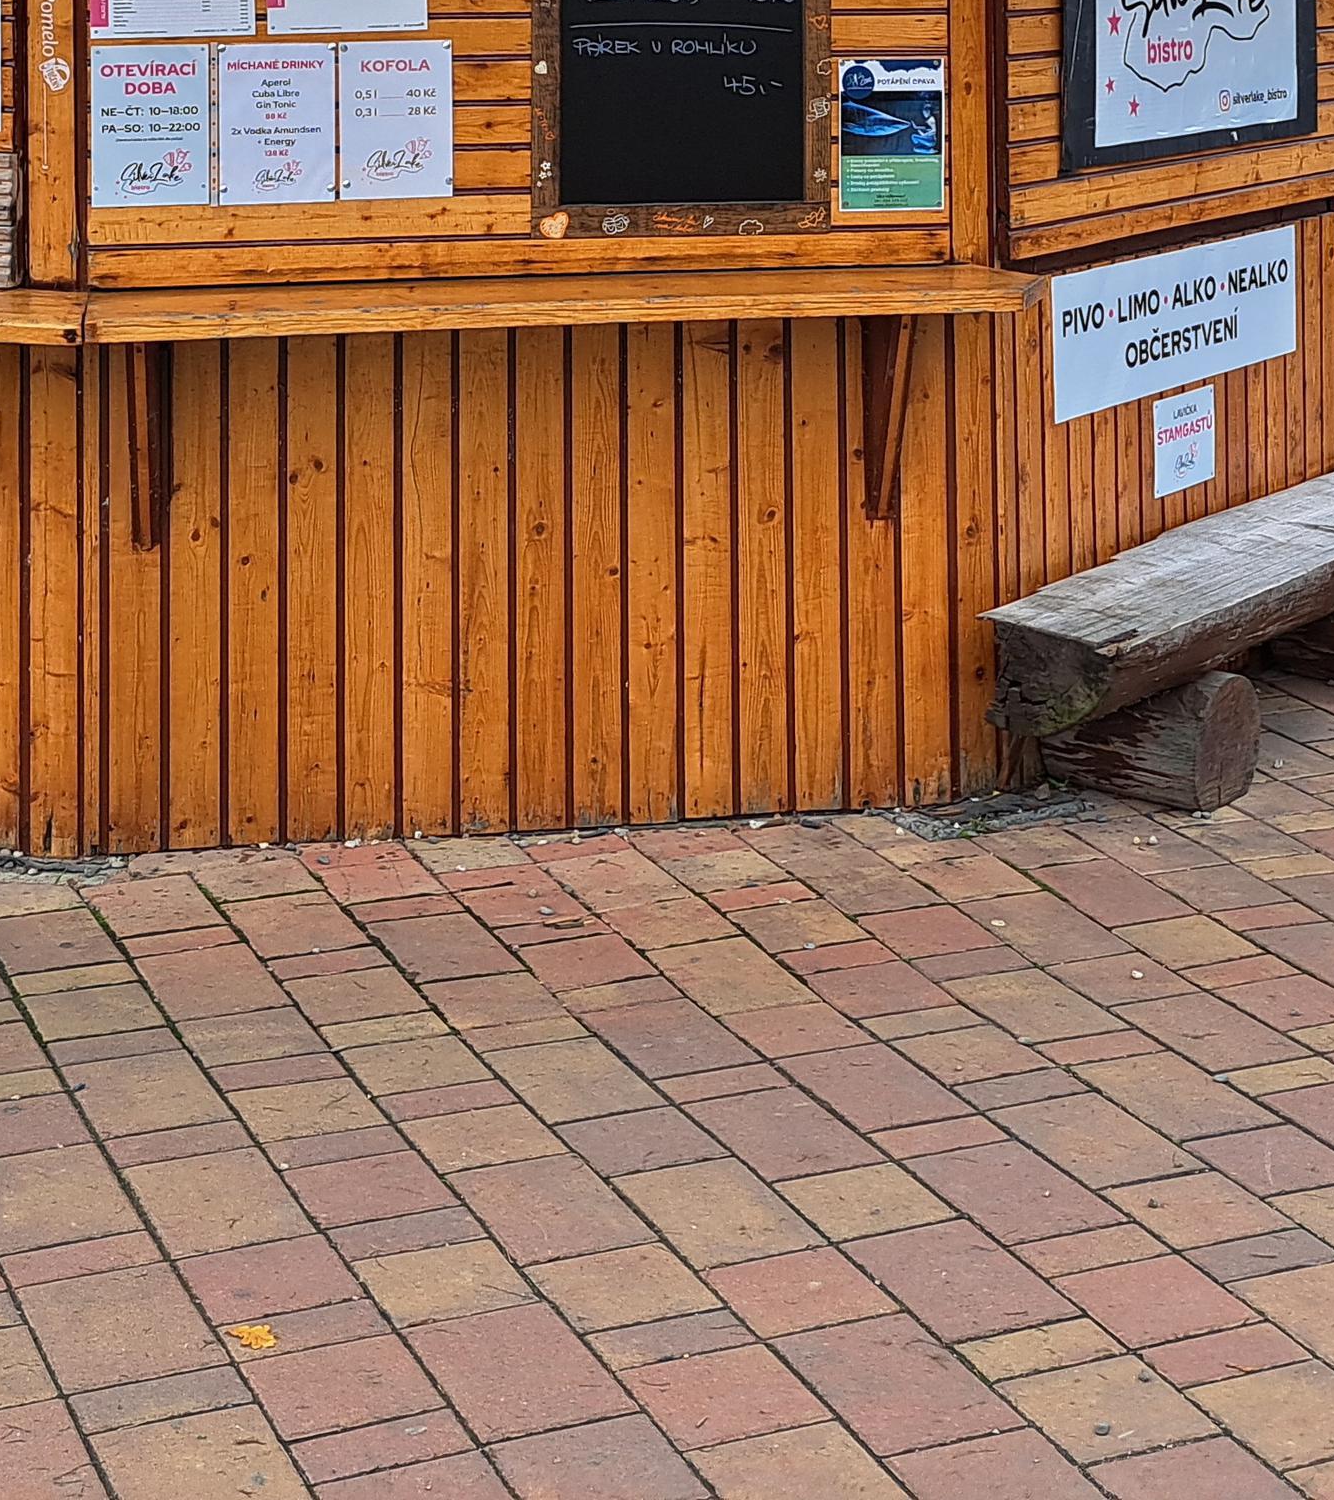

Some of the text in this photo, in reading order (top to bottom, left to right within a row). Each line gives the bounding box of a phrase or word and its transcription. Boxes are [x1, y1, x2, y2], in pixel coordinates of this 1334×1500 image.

[572, 34, 642, 57] PÁREK
[671, 33, 757, 55] ROHLÍKU
[1147, 36, 1193, 65] bistro
[100, 60, 197, 77] OTEVÍRACÍ
[227, 60, 324, 71] MÍCHANÉ DRINKY
[360, 59, 431, 73] KOFOLA
[125, 82, 177, 95] DOBA
[261, 78, 291, 88] Aperol
[251, 89, 300, 98] Cuba Libre
[354, 90, 372, 100] 0,5
[406, 89, 421, 98] 40
[423, 88, 437, 98] Kč
[1232, 88, 1288, 106] silverlake_bistro
[255, 100, 296, 109] Gin Tonic
[354, 108, 373, 118] 0,3
[407, 107, 421, 116] 28
[423, 106, 437, 116] Kč
[231, 126, 322, 136] 2x Vodka Amundsen
[264, 138, 296, 147] Energy
[1062, 258, 1289, 338] PIVO LIMO ALKO NEALKO
[1125, 307, 1240, 369] OBČERSTVENÍ
